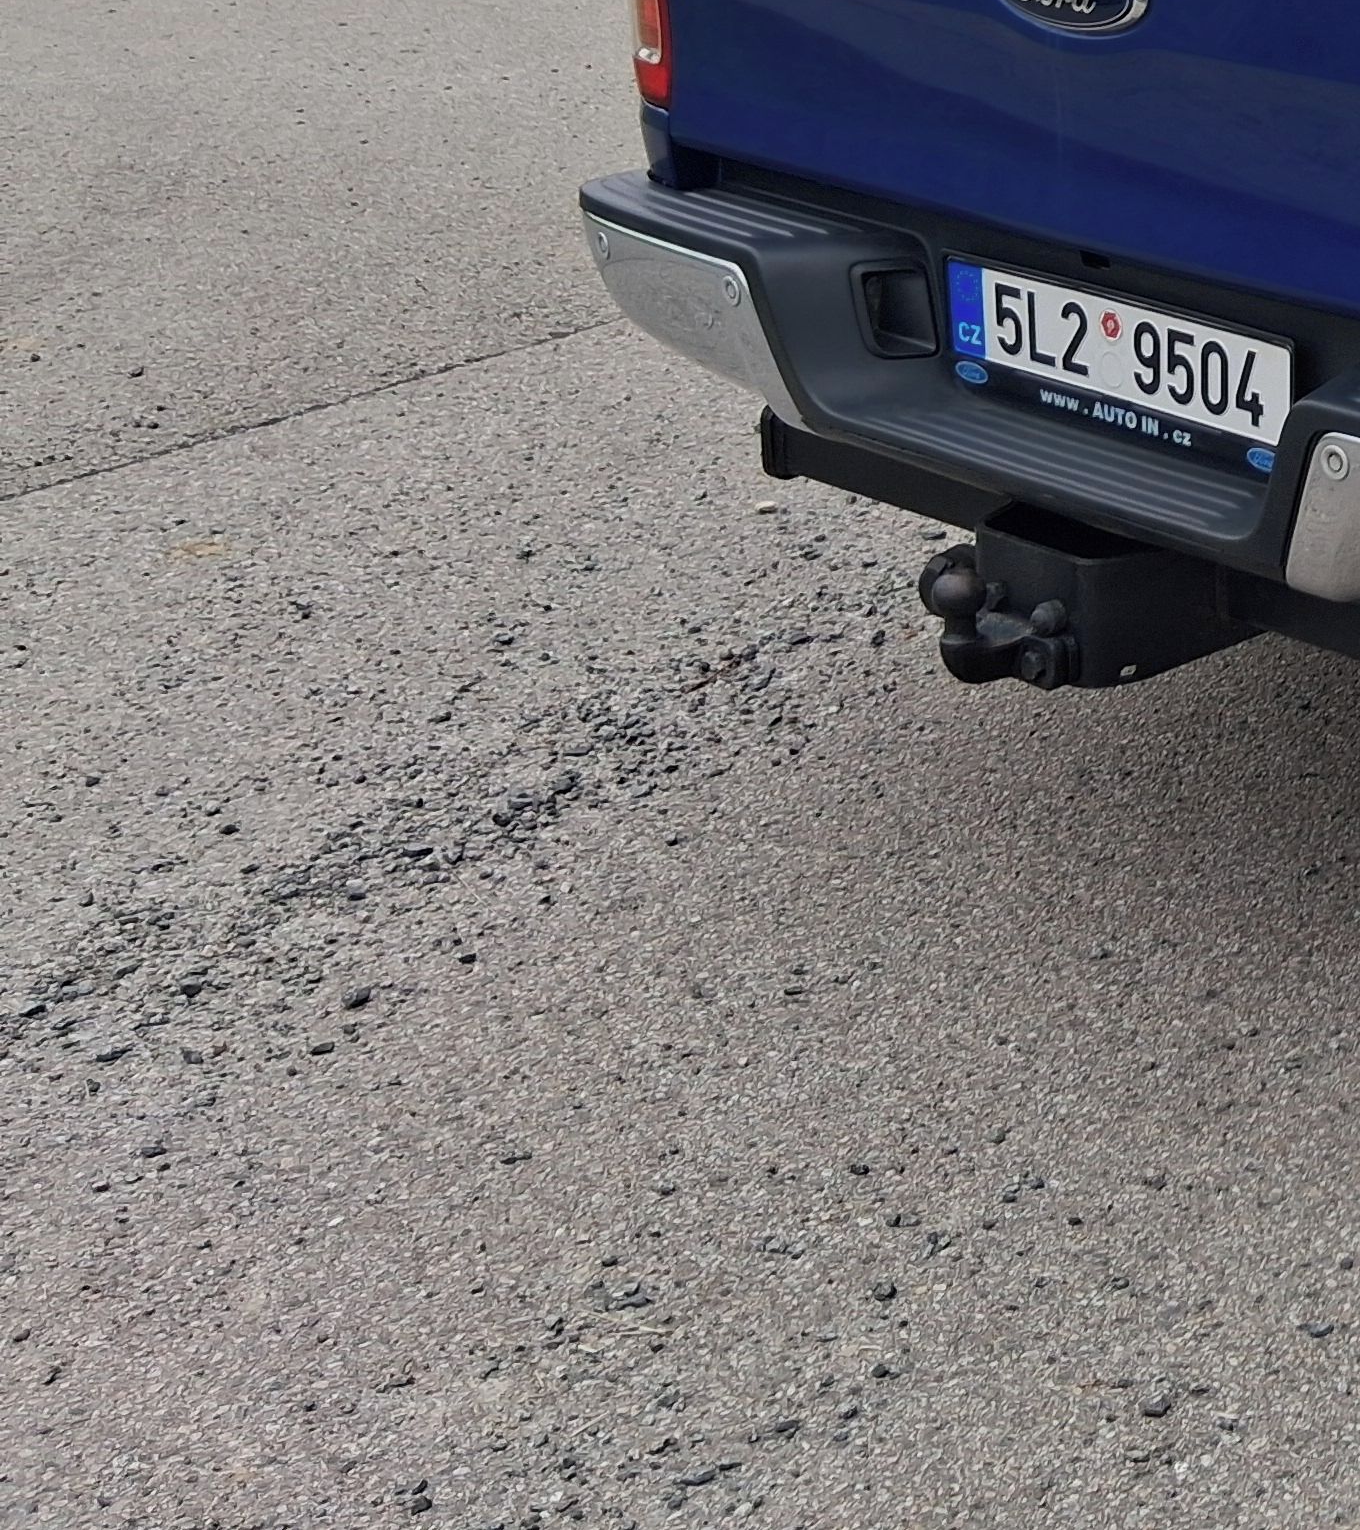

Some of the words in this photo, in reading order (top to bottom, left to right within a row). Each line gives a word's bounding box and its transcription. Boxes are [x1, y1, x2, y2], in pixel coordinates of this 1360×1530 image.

[957, 321, 983, 346] CZ
[994, 281, 1090, 377] 5L2
[1133, 320, 1265, 428] 9504
